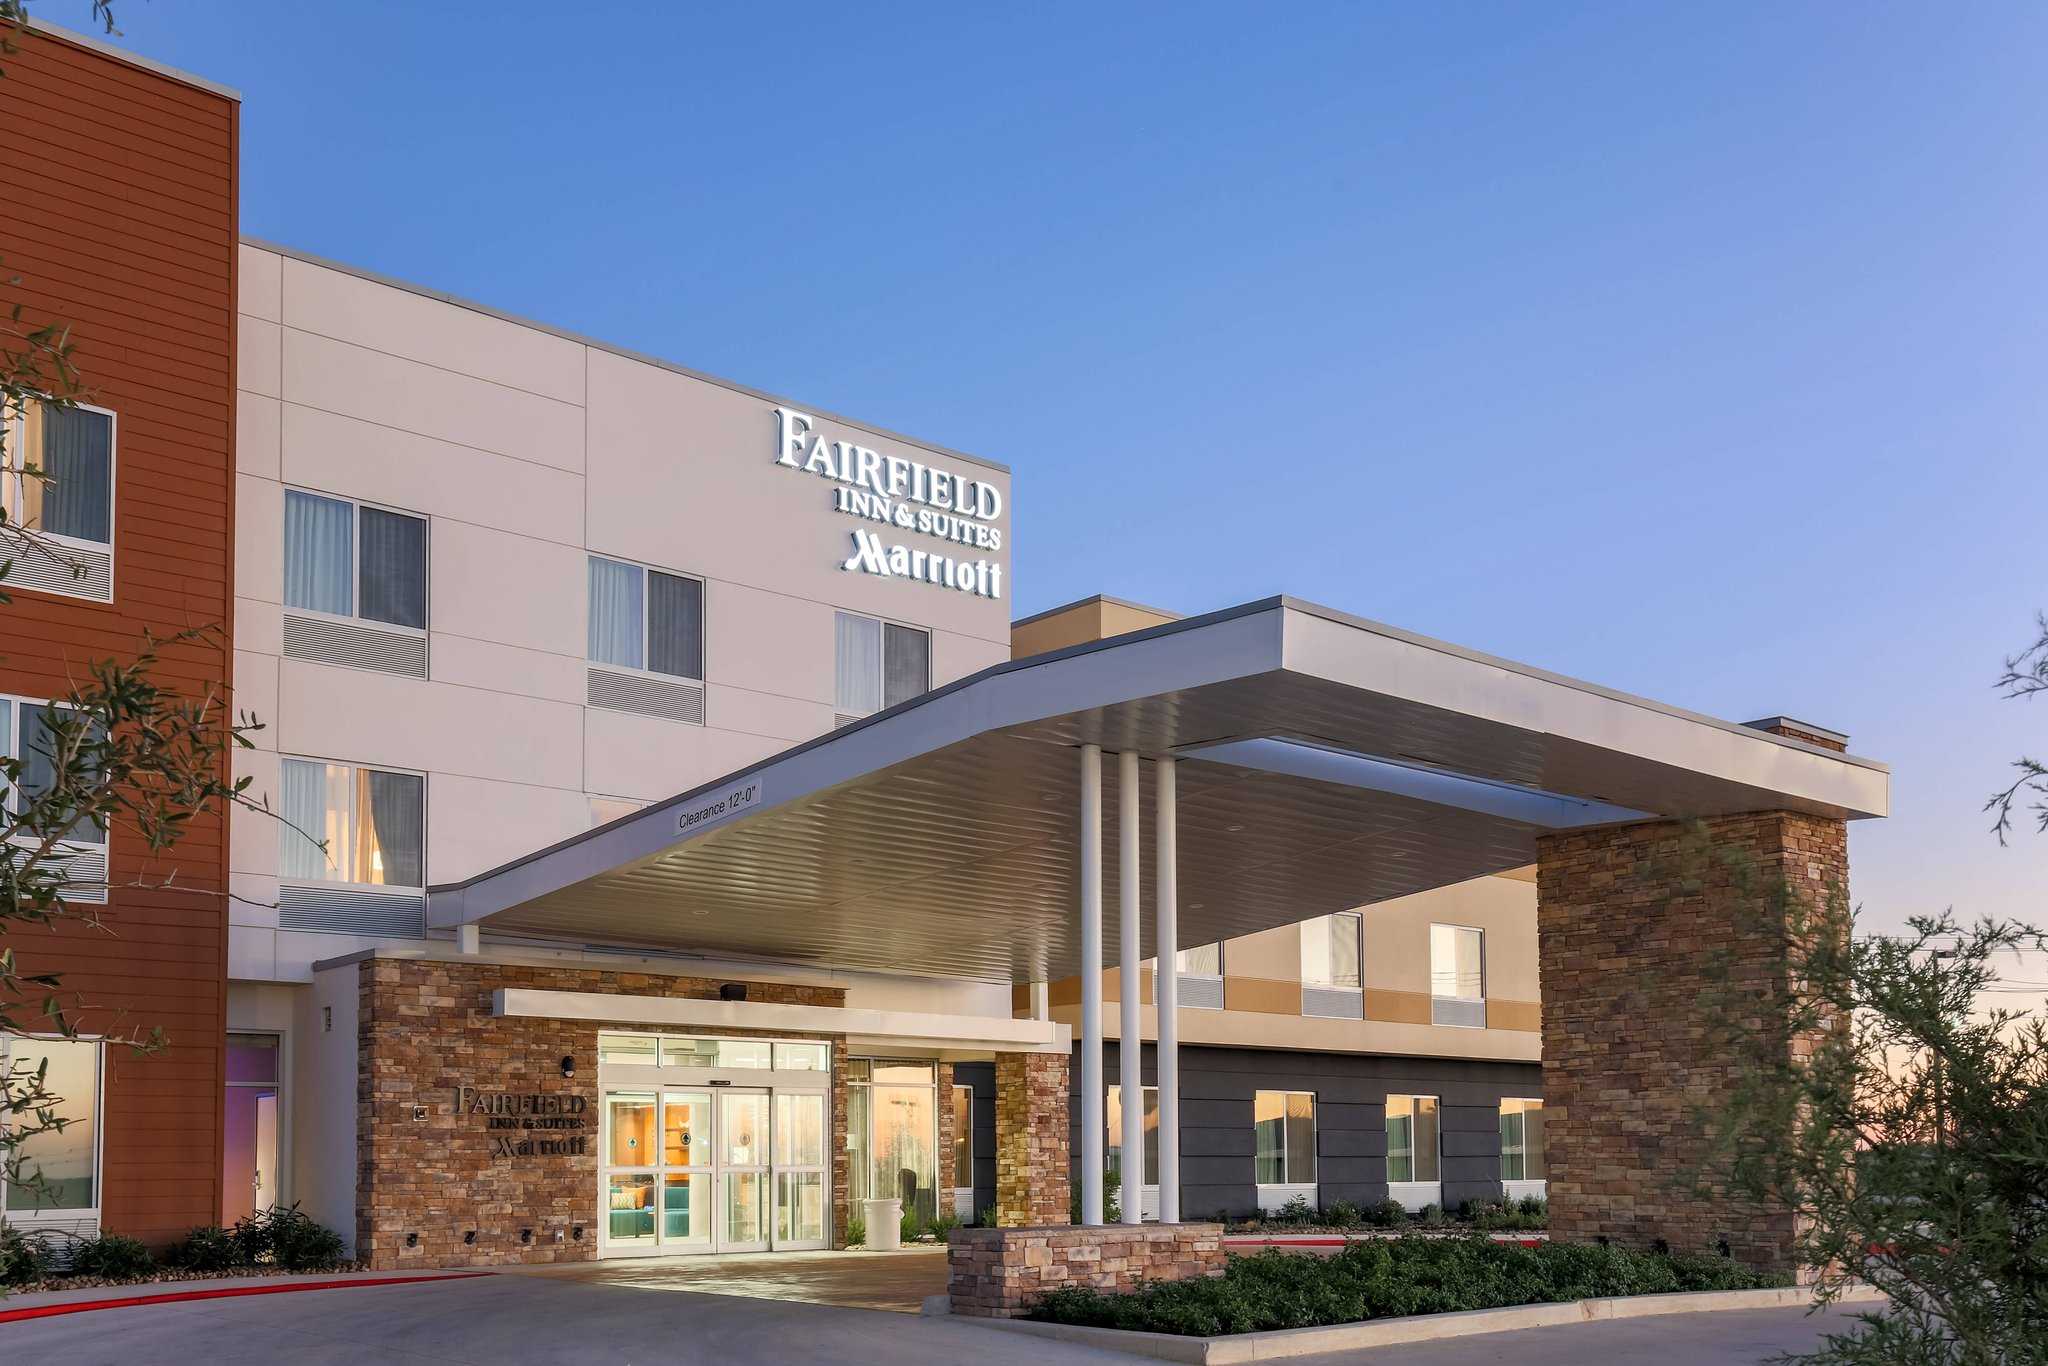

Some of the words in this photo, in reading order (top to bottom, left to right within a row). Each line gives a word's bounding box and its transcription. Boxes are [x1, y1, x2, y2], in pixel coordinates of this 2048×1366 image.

[775, 406, 1002, 520] FAIRFIELD
[835, 487, 891, 524] INN
[894, 503, 918, 528] &
[919, 508, 1001, 551] SUITES
[843, 528, 1002, 598] Marriott
[679, 801, 726, 828] Clearance
[456, 1085, 586, 1115] FAIRFIELD
[489, 1118, 519, 1129] INN
[535, 1118, 585, 1129] SUITES
[492, 1136, 586, 1159] Marriott
